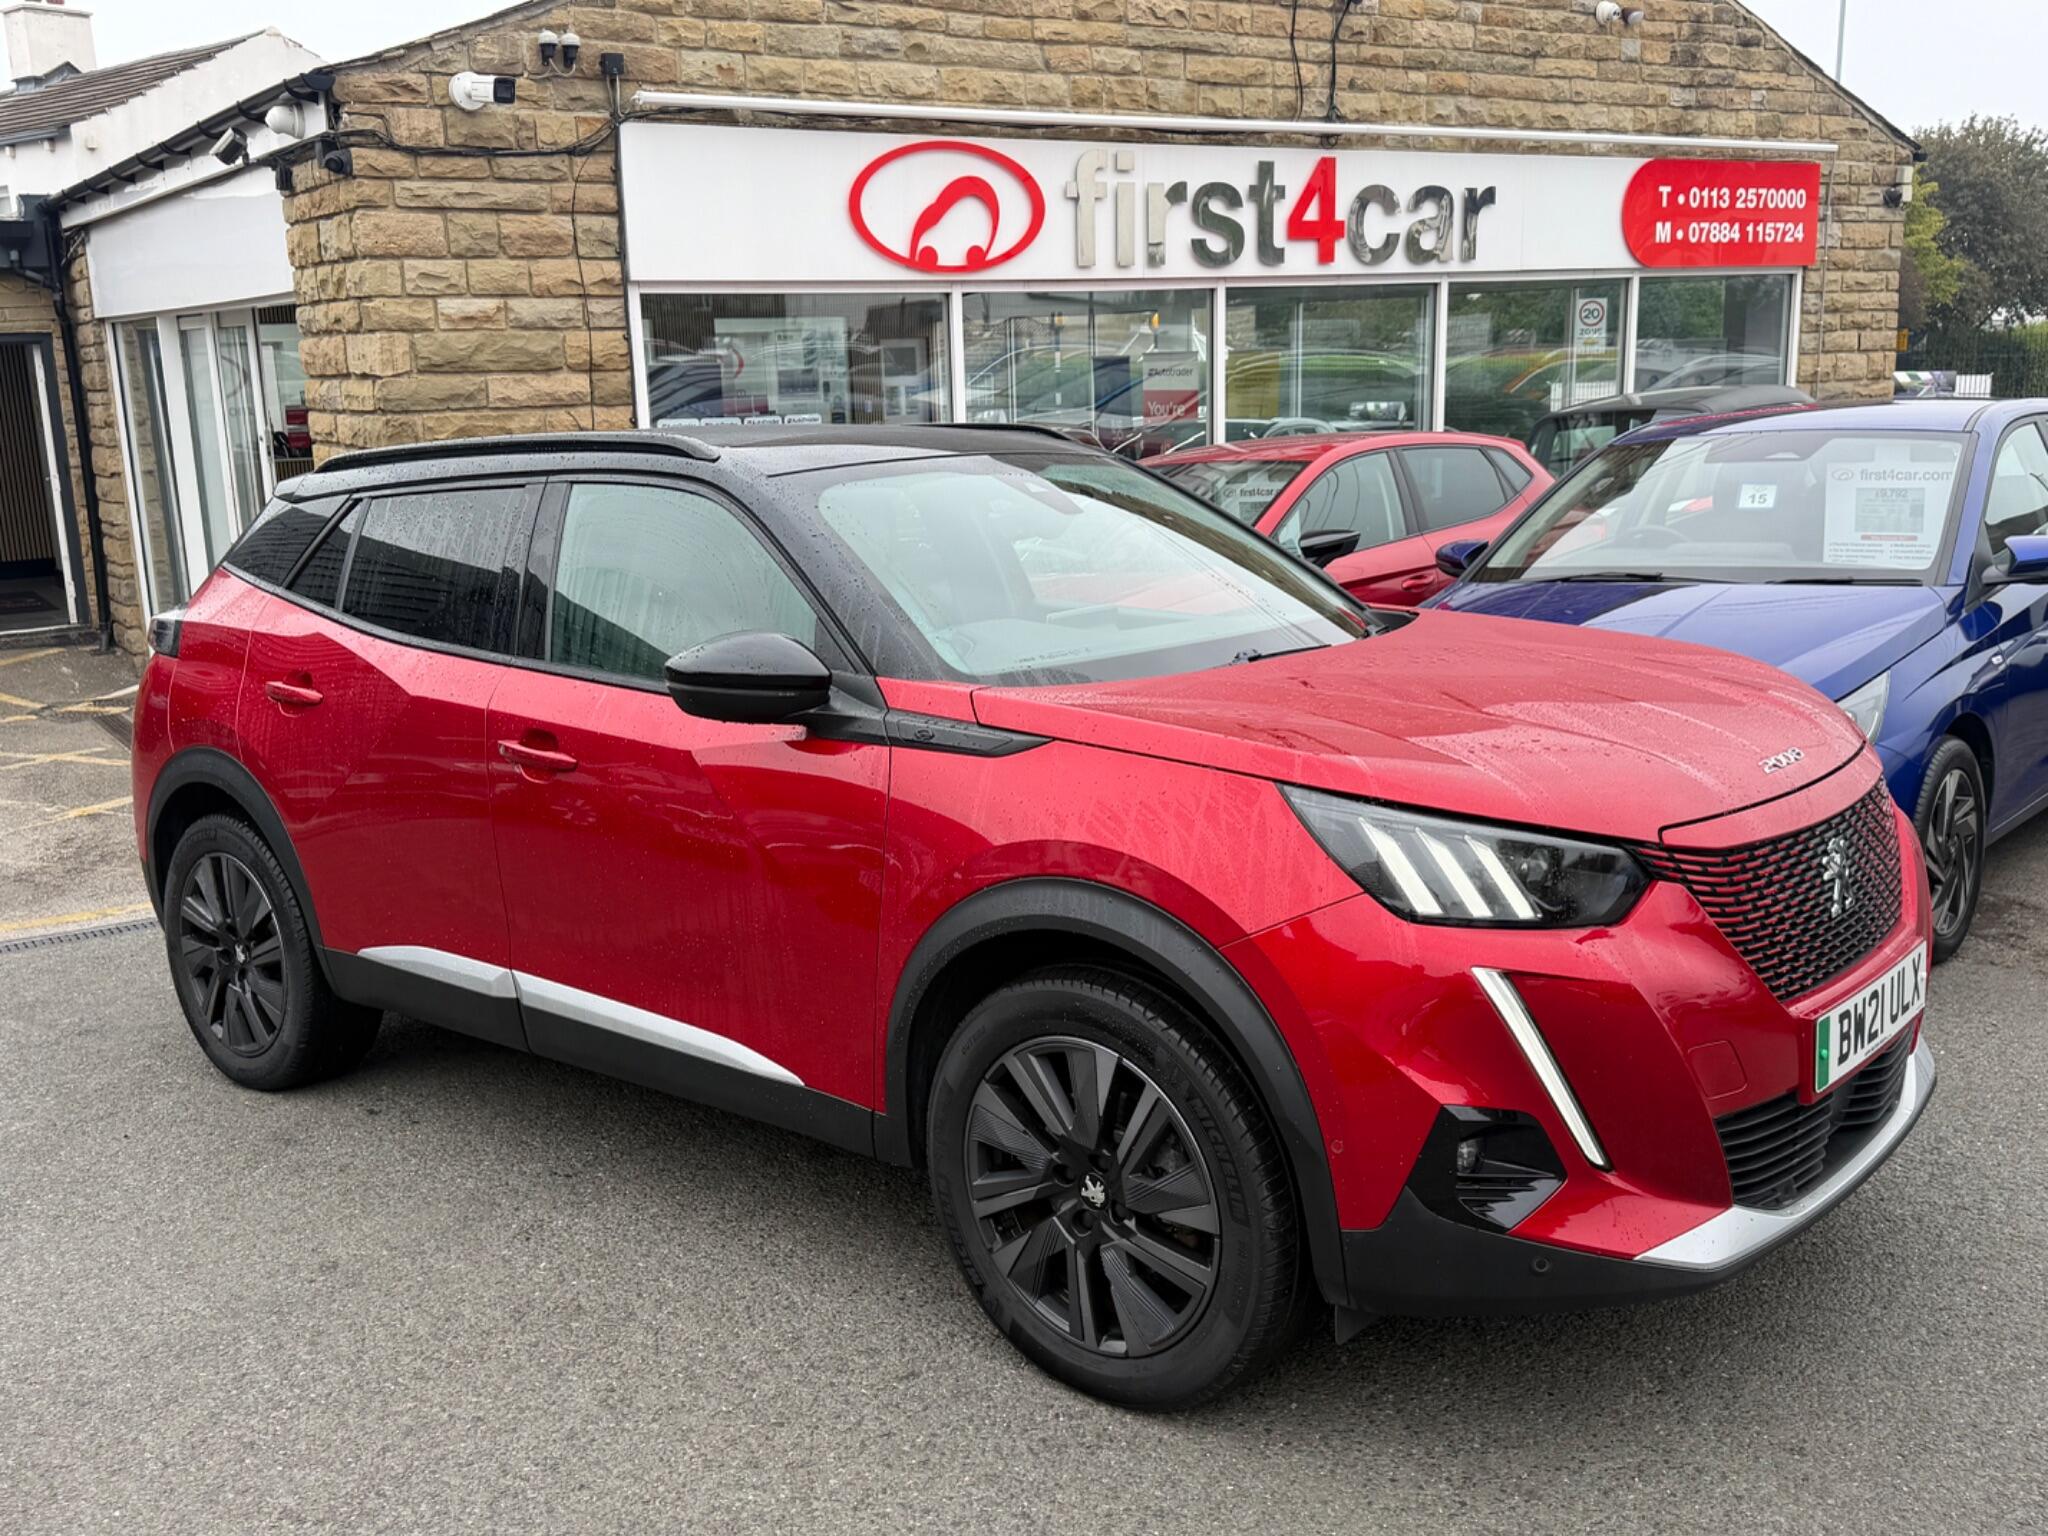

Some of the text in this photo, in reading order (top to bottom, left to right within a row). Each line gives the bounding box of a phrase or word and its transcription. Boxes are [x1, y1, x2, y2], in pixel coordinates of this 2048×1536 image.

[1066, 149, 1496, 267] first4car
[1659, 185, 1806, 209] T 0113 2570000
[1655, 221, 1804, 243] M 07884 115724
[1583, 308, 1600, 319] 20
[1148, 401, 1186, 417] You're
[1748, 493, 1768, 505] 15
[1757, 746, 1805, 774] 2008
[1837, 952, 1921, 1067] BW21 ULX
